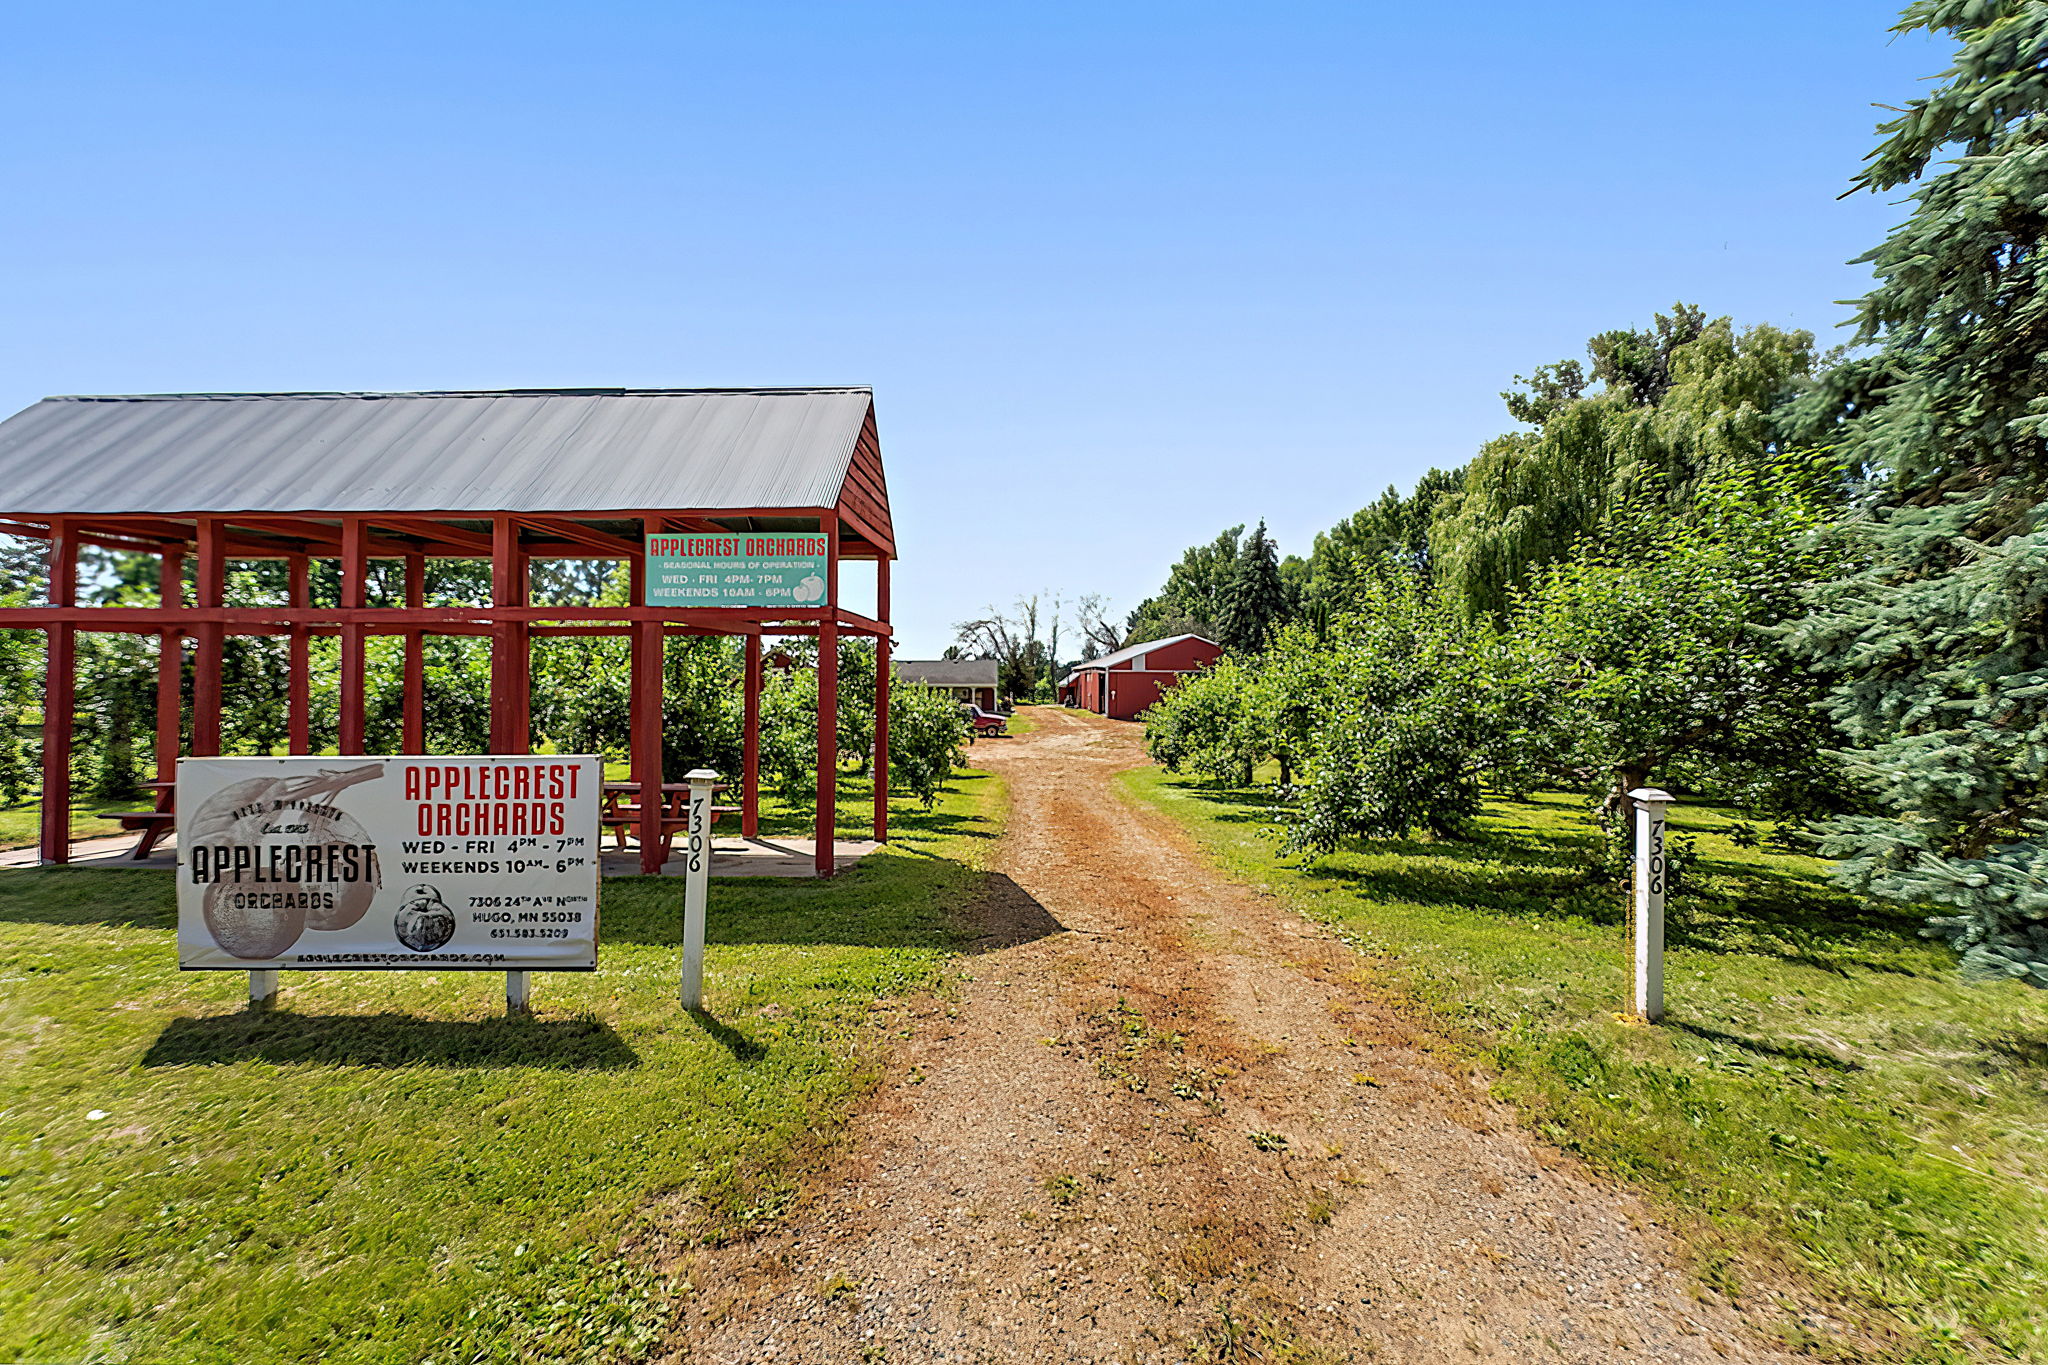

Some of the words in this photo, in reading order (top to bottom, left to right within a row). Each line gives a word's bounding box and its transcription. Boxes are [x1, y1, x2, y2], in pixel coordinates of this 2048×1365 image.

[650, 537, 740, 557] APPLECREST
[745, 537, 826, 557] ORCHARDS
[663, 561, 711, 569] SEASONAL
[713, 561, 746, 569] HOURS
[747, 561, 760, 569] OF
[762, 561, 815, 569] OPERATION
[661, 574, 689, 584] WED
[698, 574, 718, 584] FRI
[757, 574, 783, 584] 7PM
[652, 587, 719, 598] WEEKENDS
[722, 587, 755, 598] 10AM
[765, 587, 791, 598] 6PM
[405, 764, 581, 801] APPLECREST
[417, 801, 565, 836] ORCHARDS
[689, 798, 704, 872] 7306
[402, 840, 446, 854] WED
[465, 840, 495, 854] FRI
[507, 837, 537, 854] 4PM
[556, 837, 585, 853] 7PM
[191, 844, 377, 885] APPLECREST
[401, 860, 500, 874] WEEKENDS
[555, 857, 585, 874] 6PM
[1650, 819, 1664, 895] 7306
[234, 892, 334, 909] ORCHARDS
[468, 896, 502, 907] 7306
[472, 911, 515, 924] HUGO,
[517, 912, 538, 923] MN
[541, 911, 582, 923] 55038
